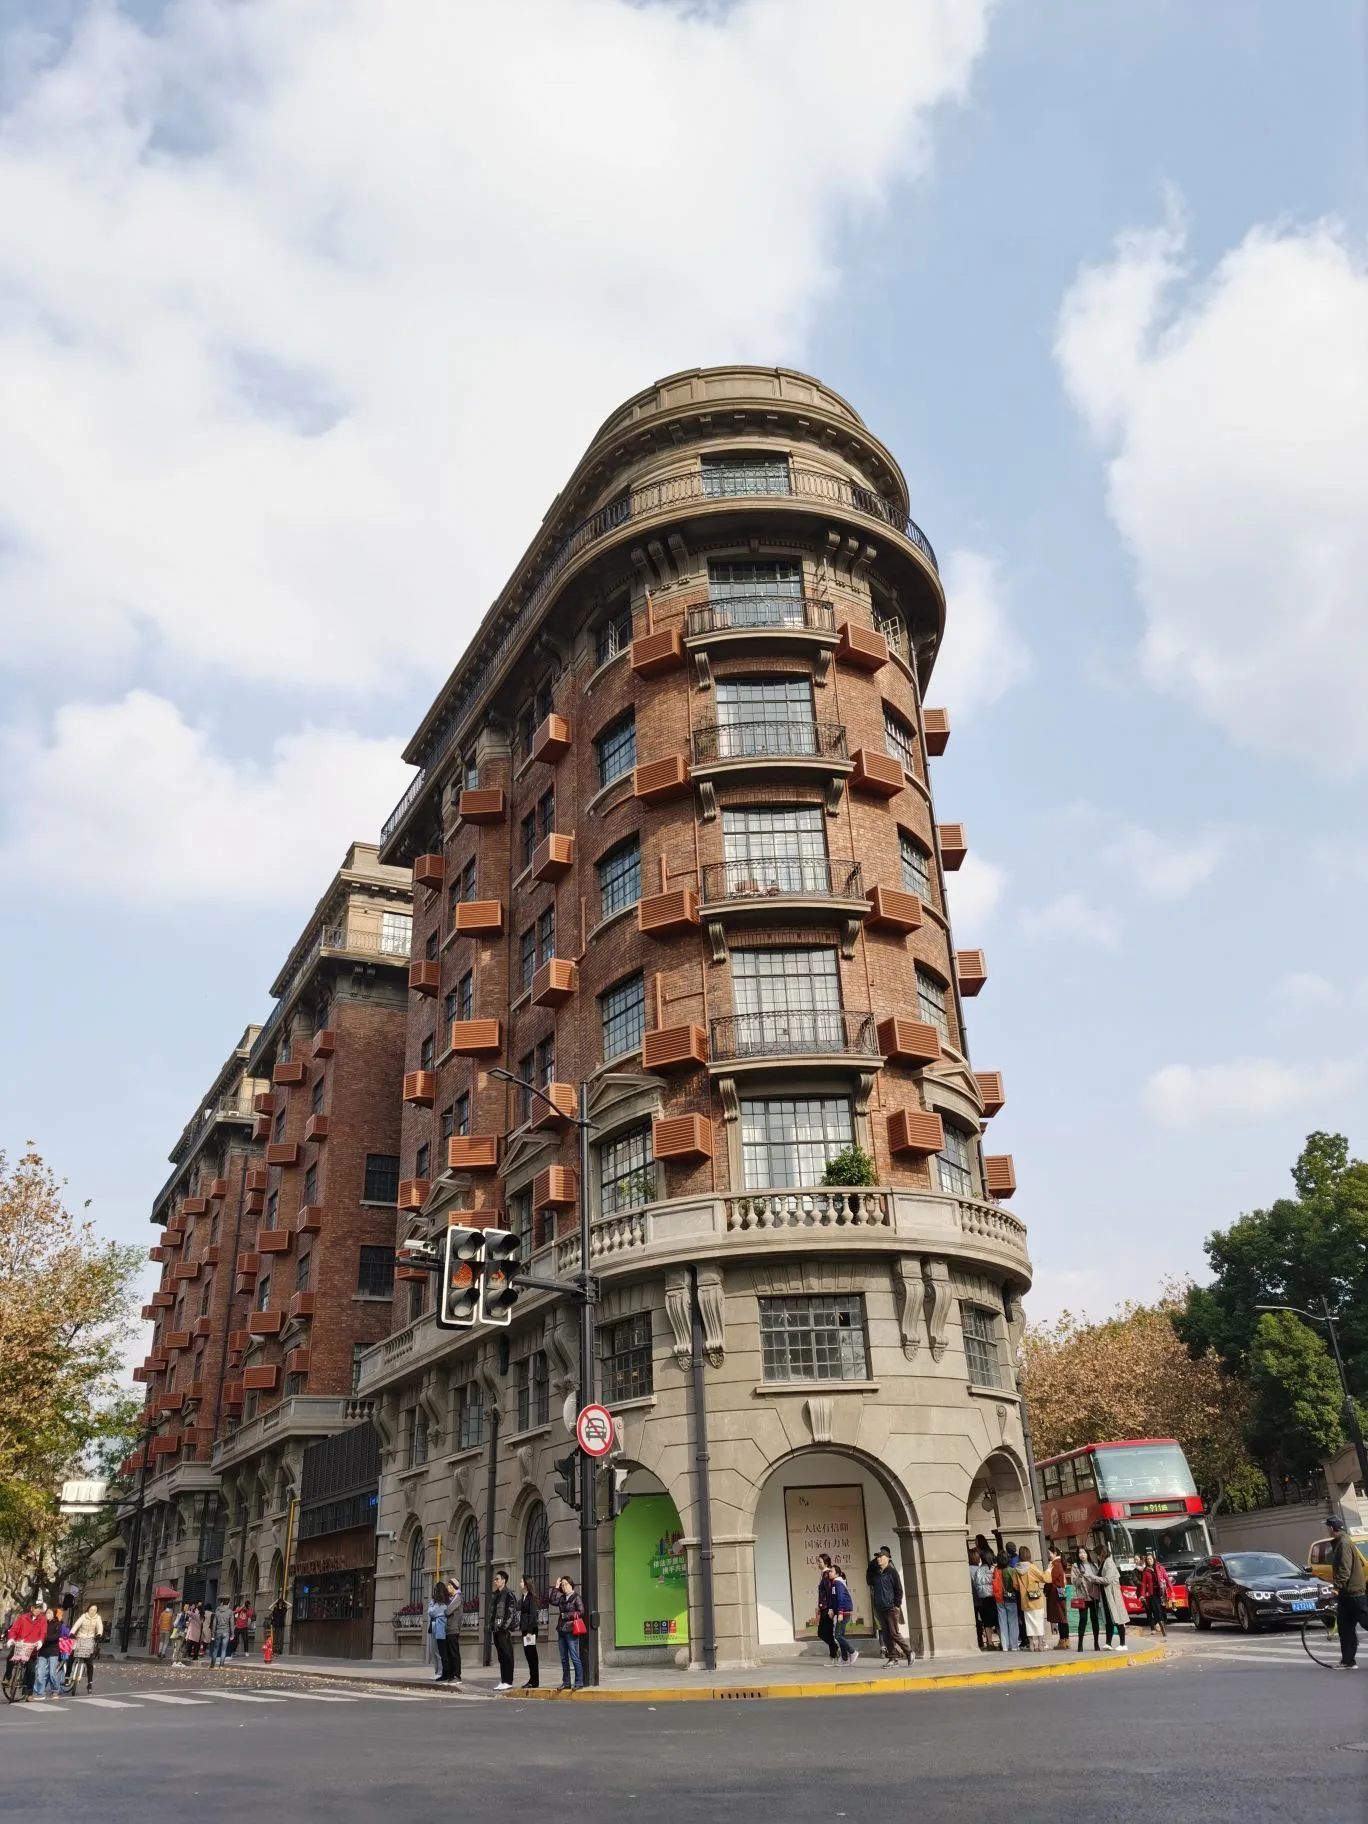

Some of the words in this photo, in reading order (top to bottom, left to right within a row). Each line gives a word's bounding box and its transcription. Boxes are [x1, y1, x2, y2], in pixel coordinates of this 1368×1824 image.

[804, 1523, 849, 1533] 人民有信仰
[804, 1539, 850, 1549] 国家有力量
